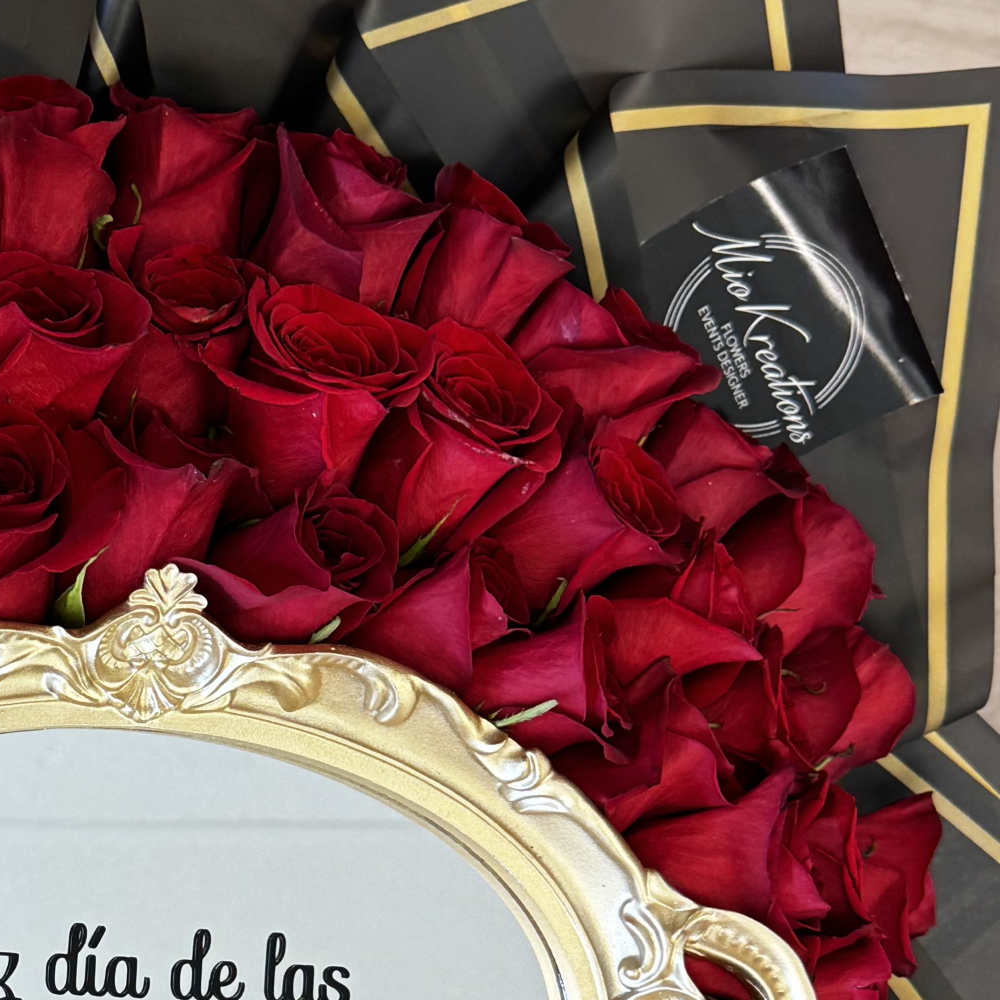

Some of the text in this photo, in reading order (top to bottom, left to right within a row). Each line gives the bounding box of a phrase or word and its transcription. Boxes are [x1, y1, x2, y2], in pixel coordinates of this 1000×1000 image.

[692, 222, 815, 445] Mio Kreations
[697, 304, 749, 409] EVENTS DESIGNER
[720, 321, 751, 379] FLOWERS
[45, 922, 151, 999] día
